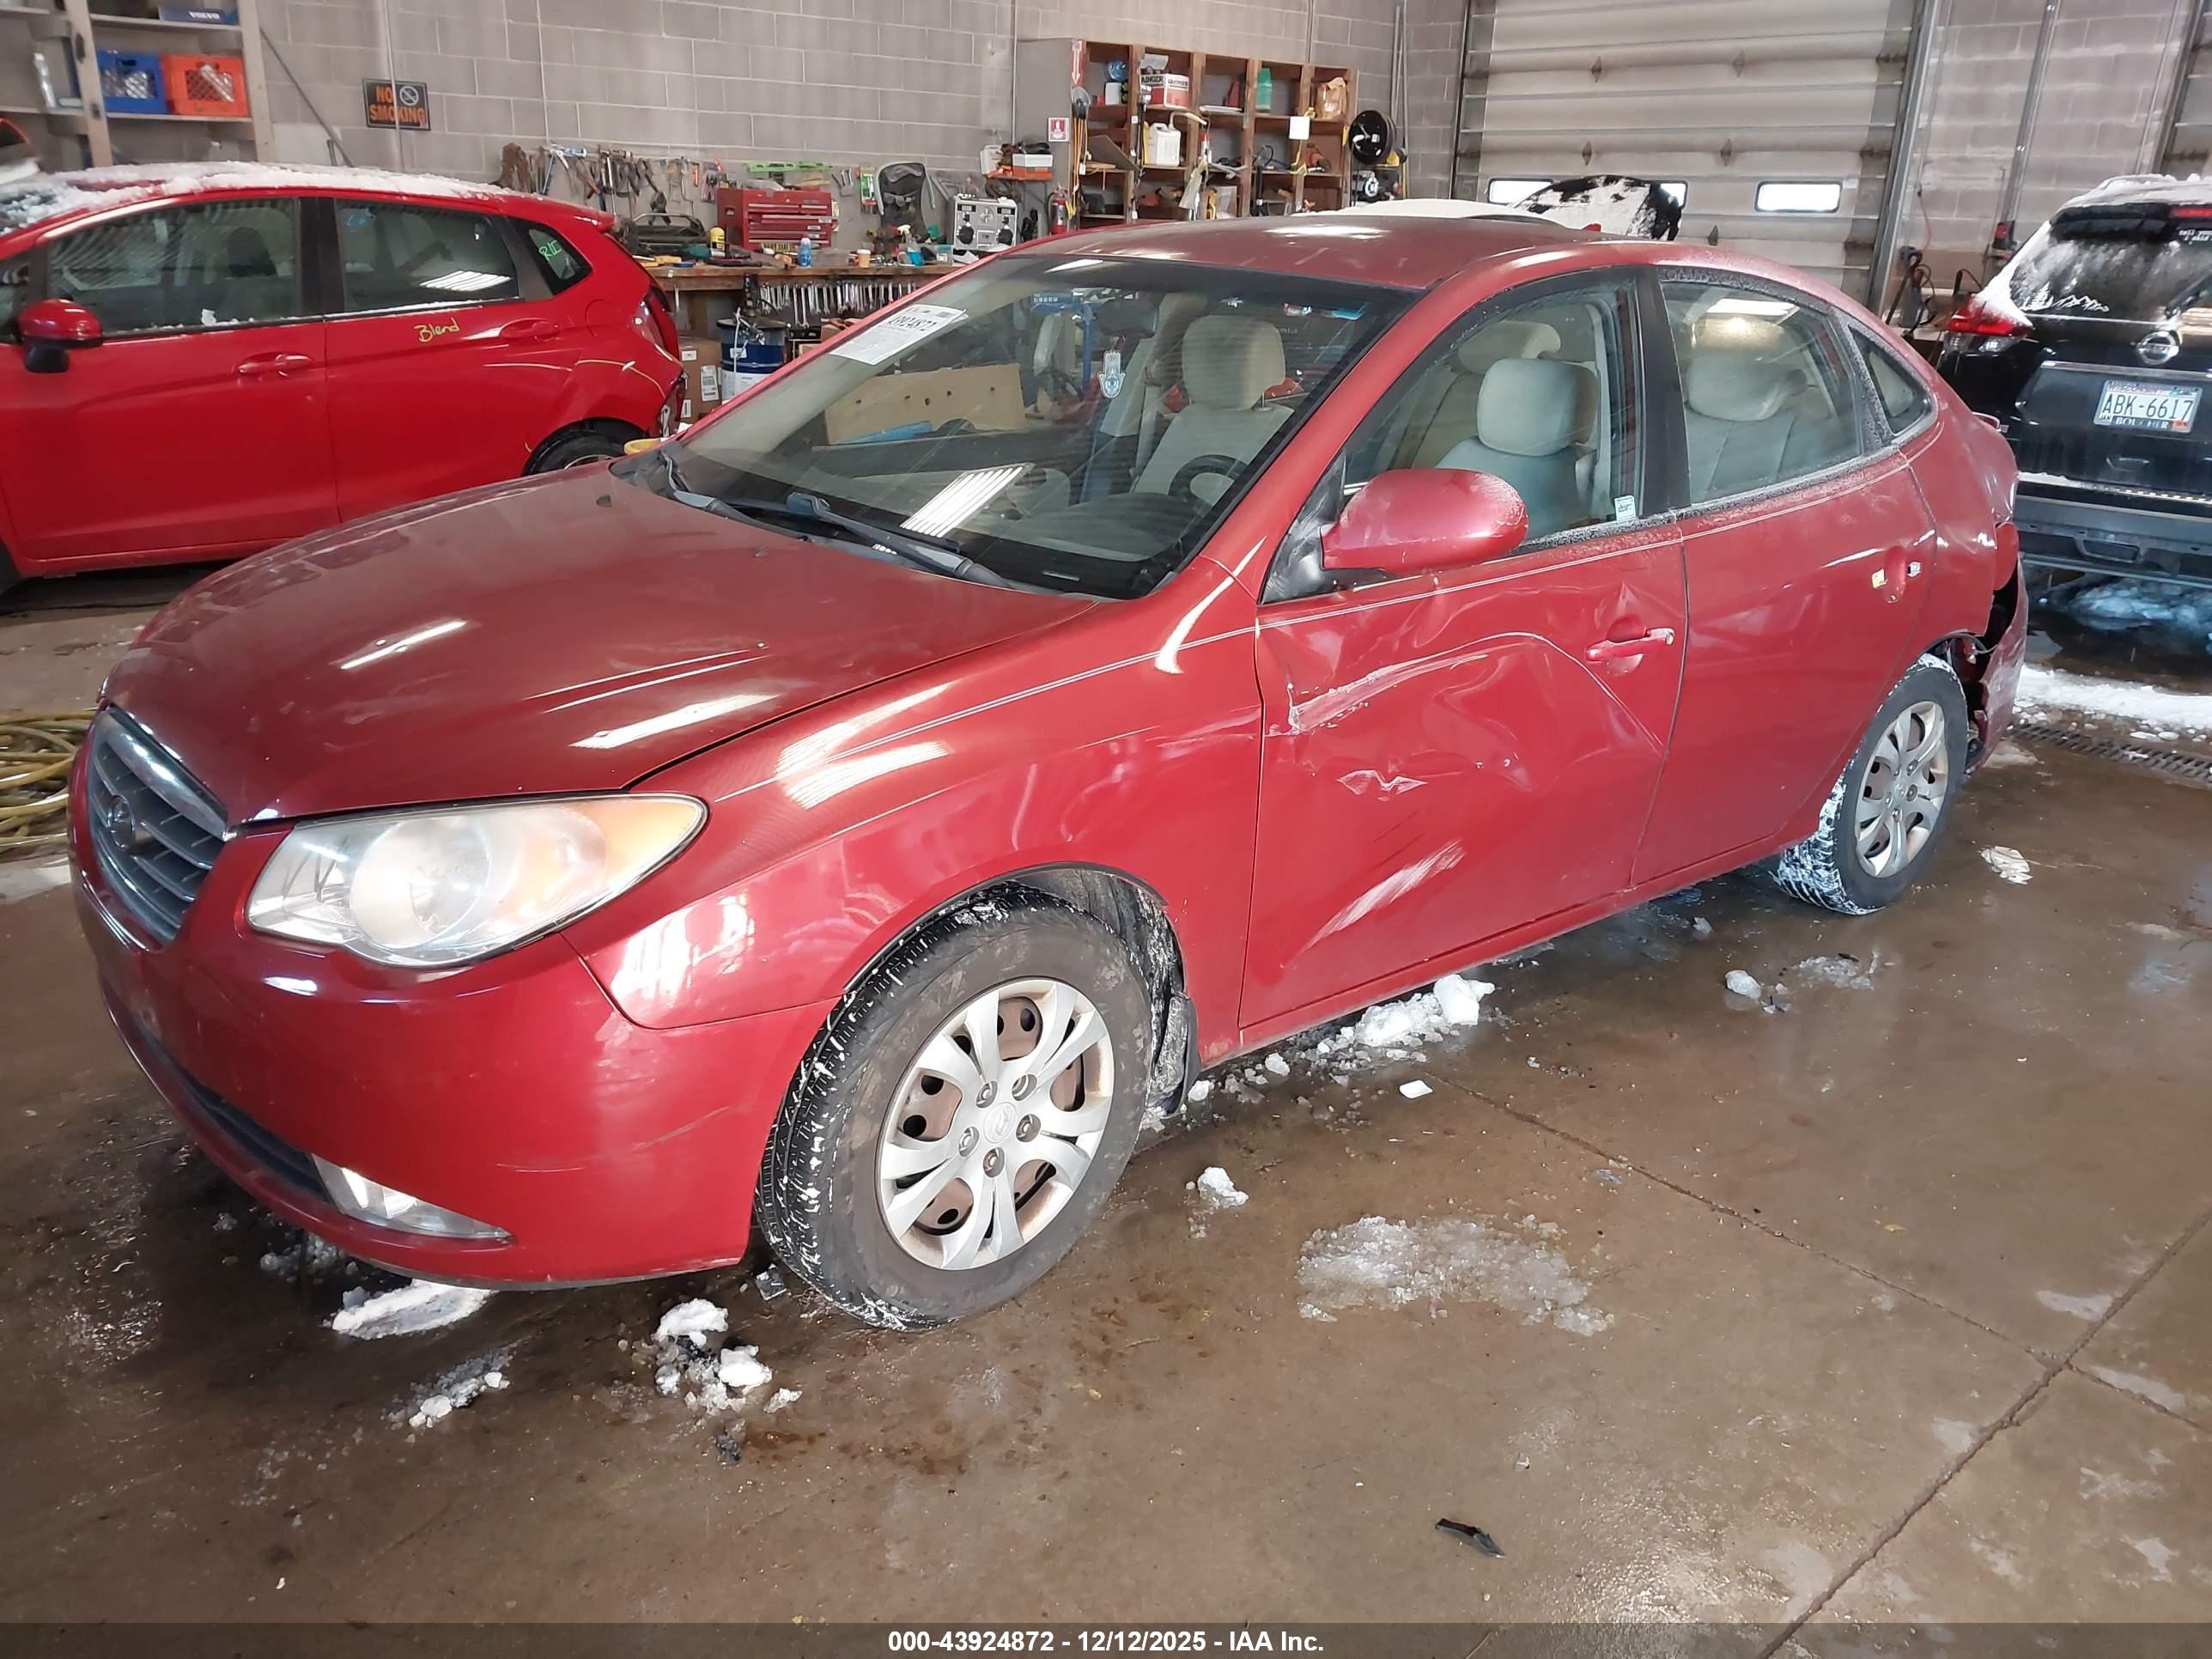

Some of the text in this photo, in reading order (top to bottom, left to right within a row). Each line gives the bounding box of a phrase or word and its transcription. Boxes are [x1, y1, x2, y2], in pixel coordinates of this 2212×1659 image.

[375, 86, 393, 103] NO
[369, 104, 426, 123] SMOKING
[413, 317, 460, 343] Blend
[2102, 393, 2194, 421] ABK-6617
